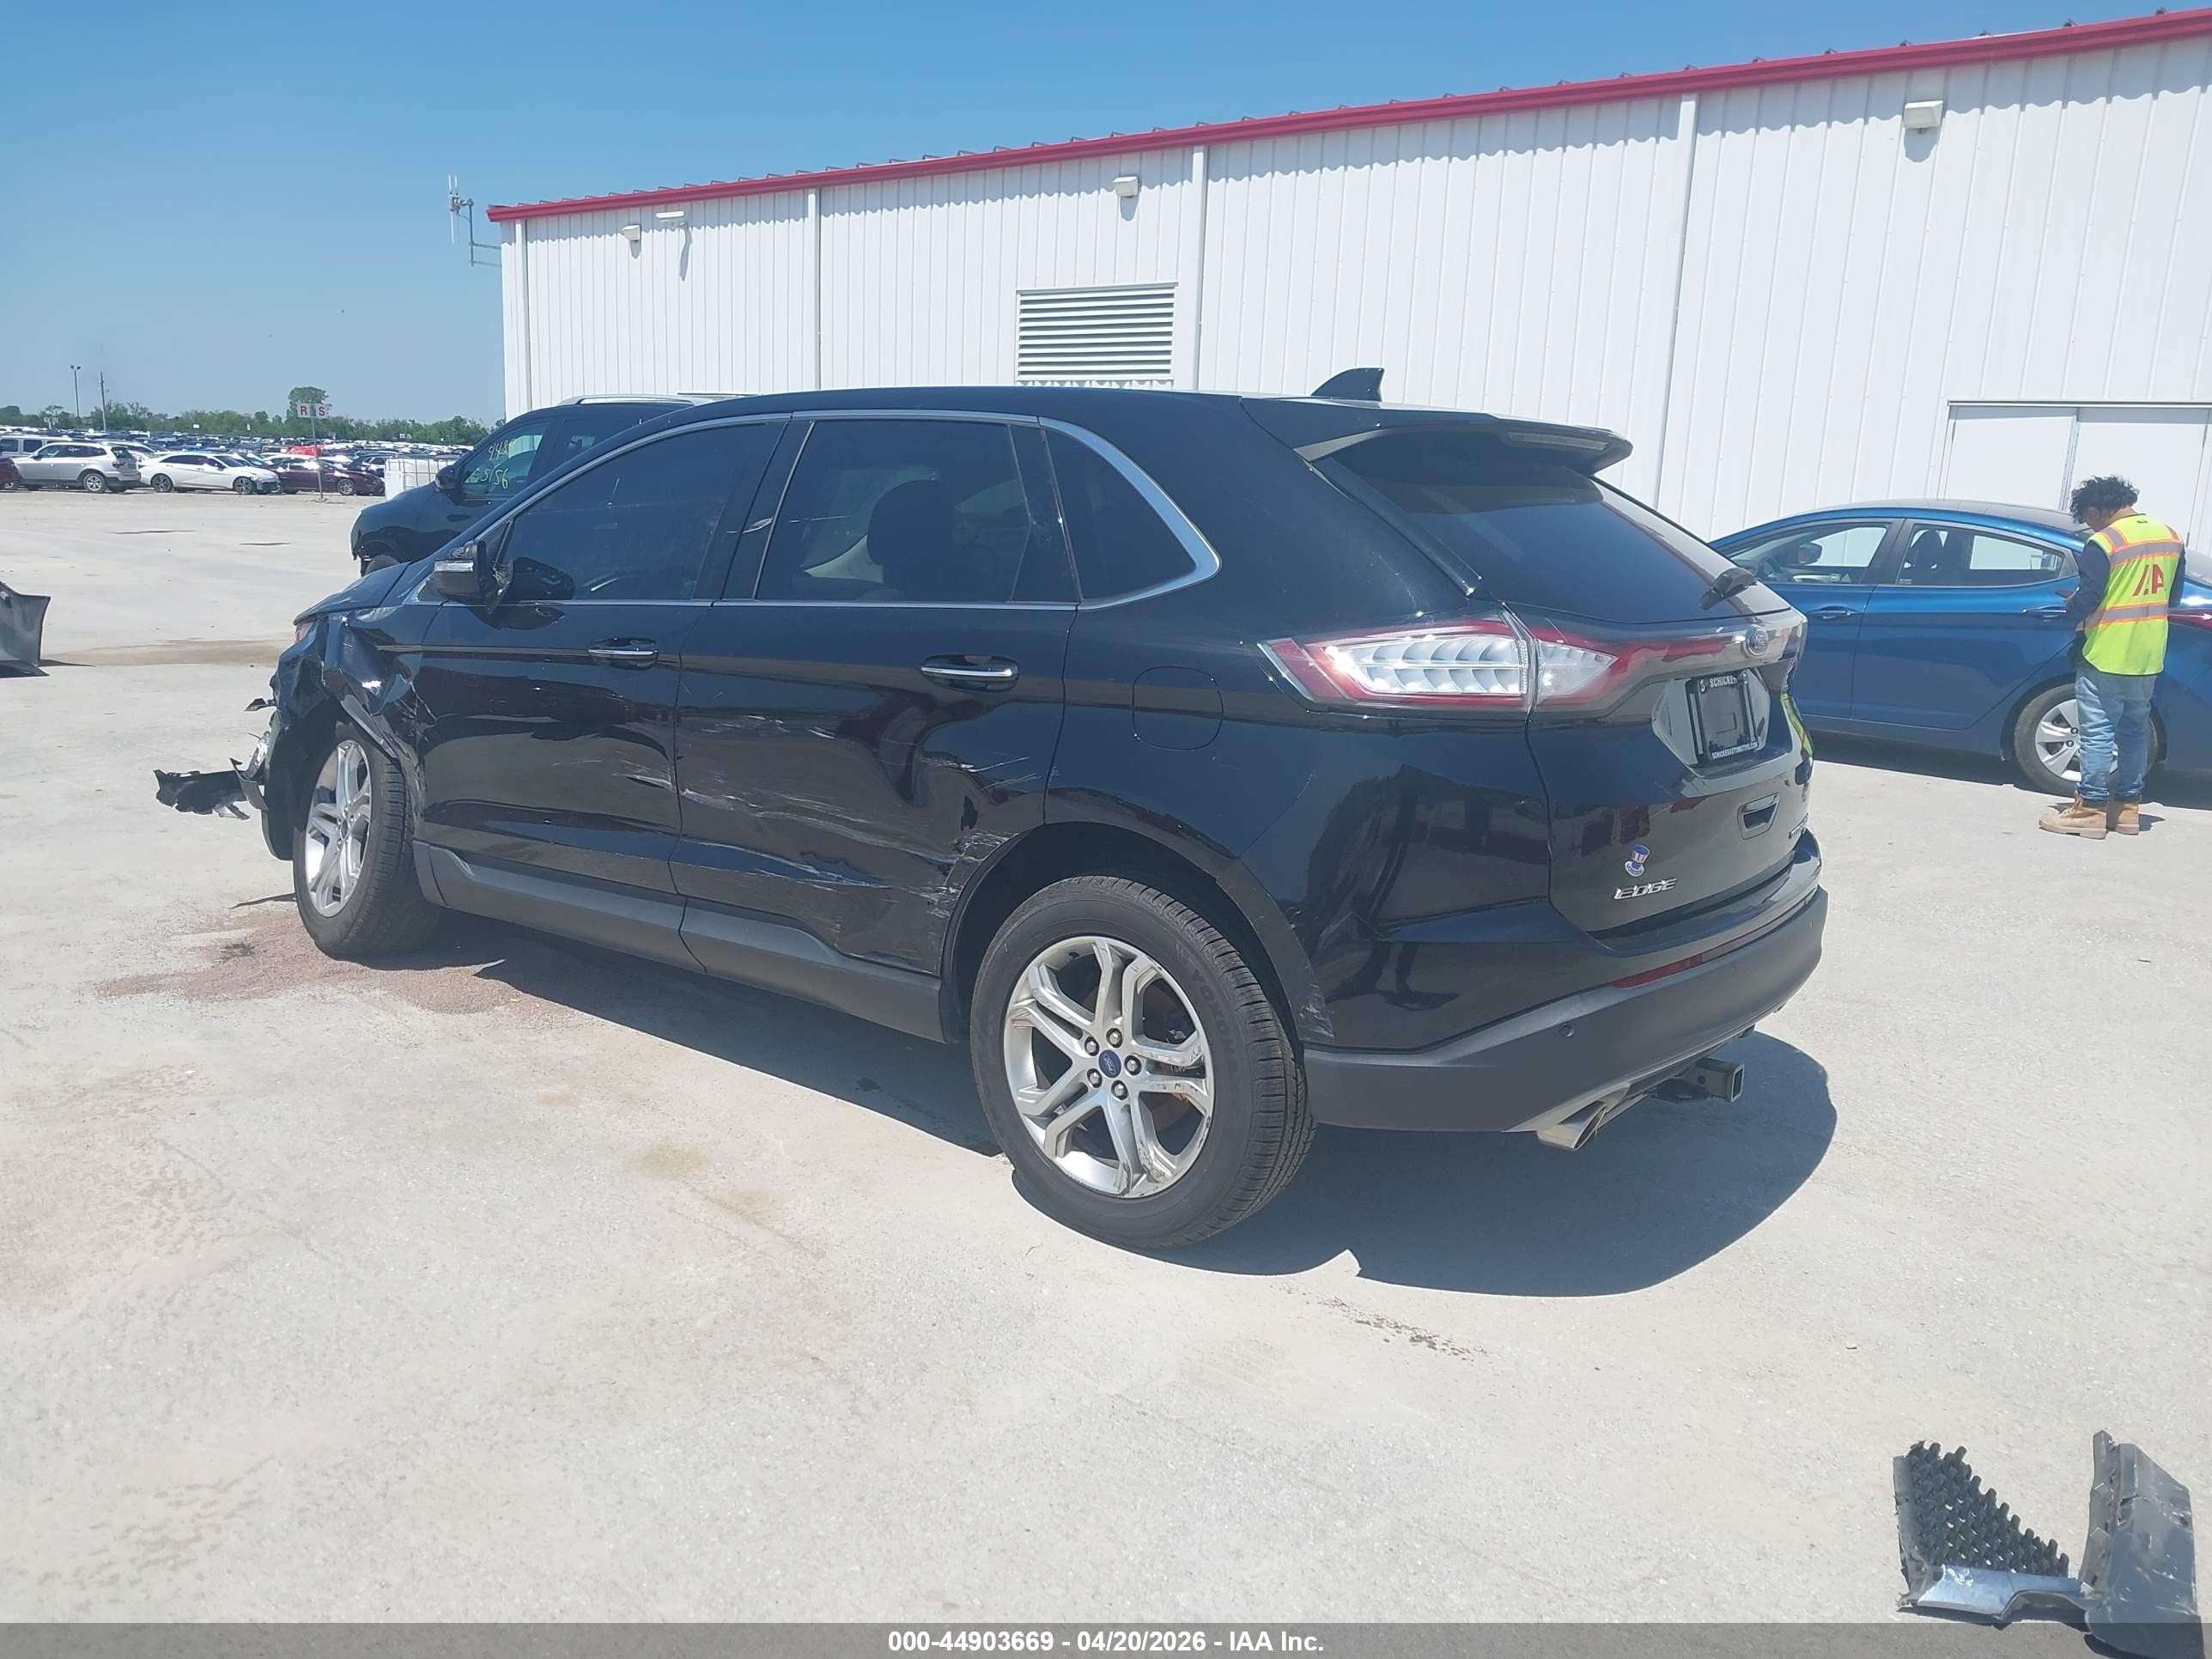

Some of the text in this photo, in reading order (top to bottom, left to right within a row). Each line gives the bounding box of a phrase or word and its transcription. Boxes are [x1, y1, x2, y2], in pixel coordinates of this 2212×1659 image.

[300, 405, 308, 416] R
[318, 406, 326, 416] S
[1613, 878, 1678, 900] EDGE
